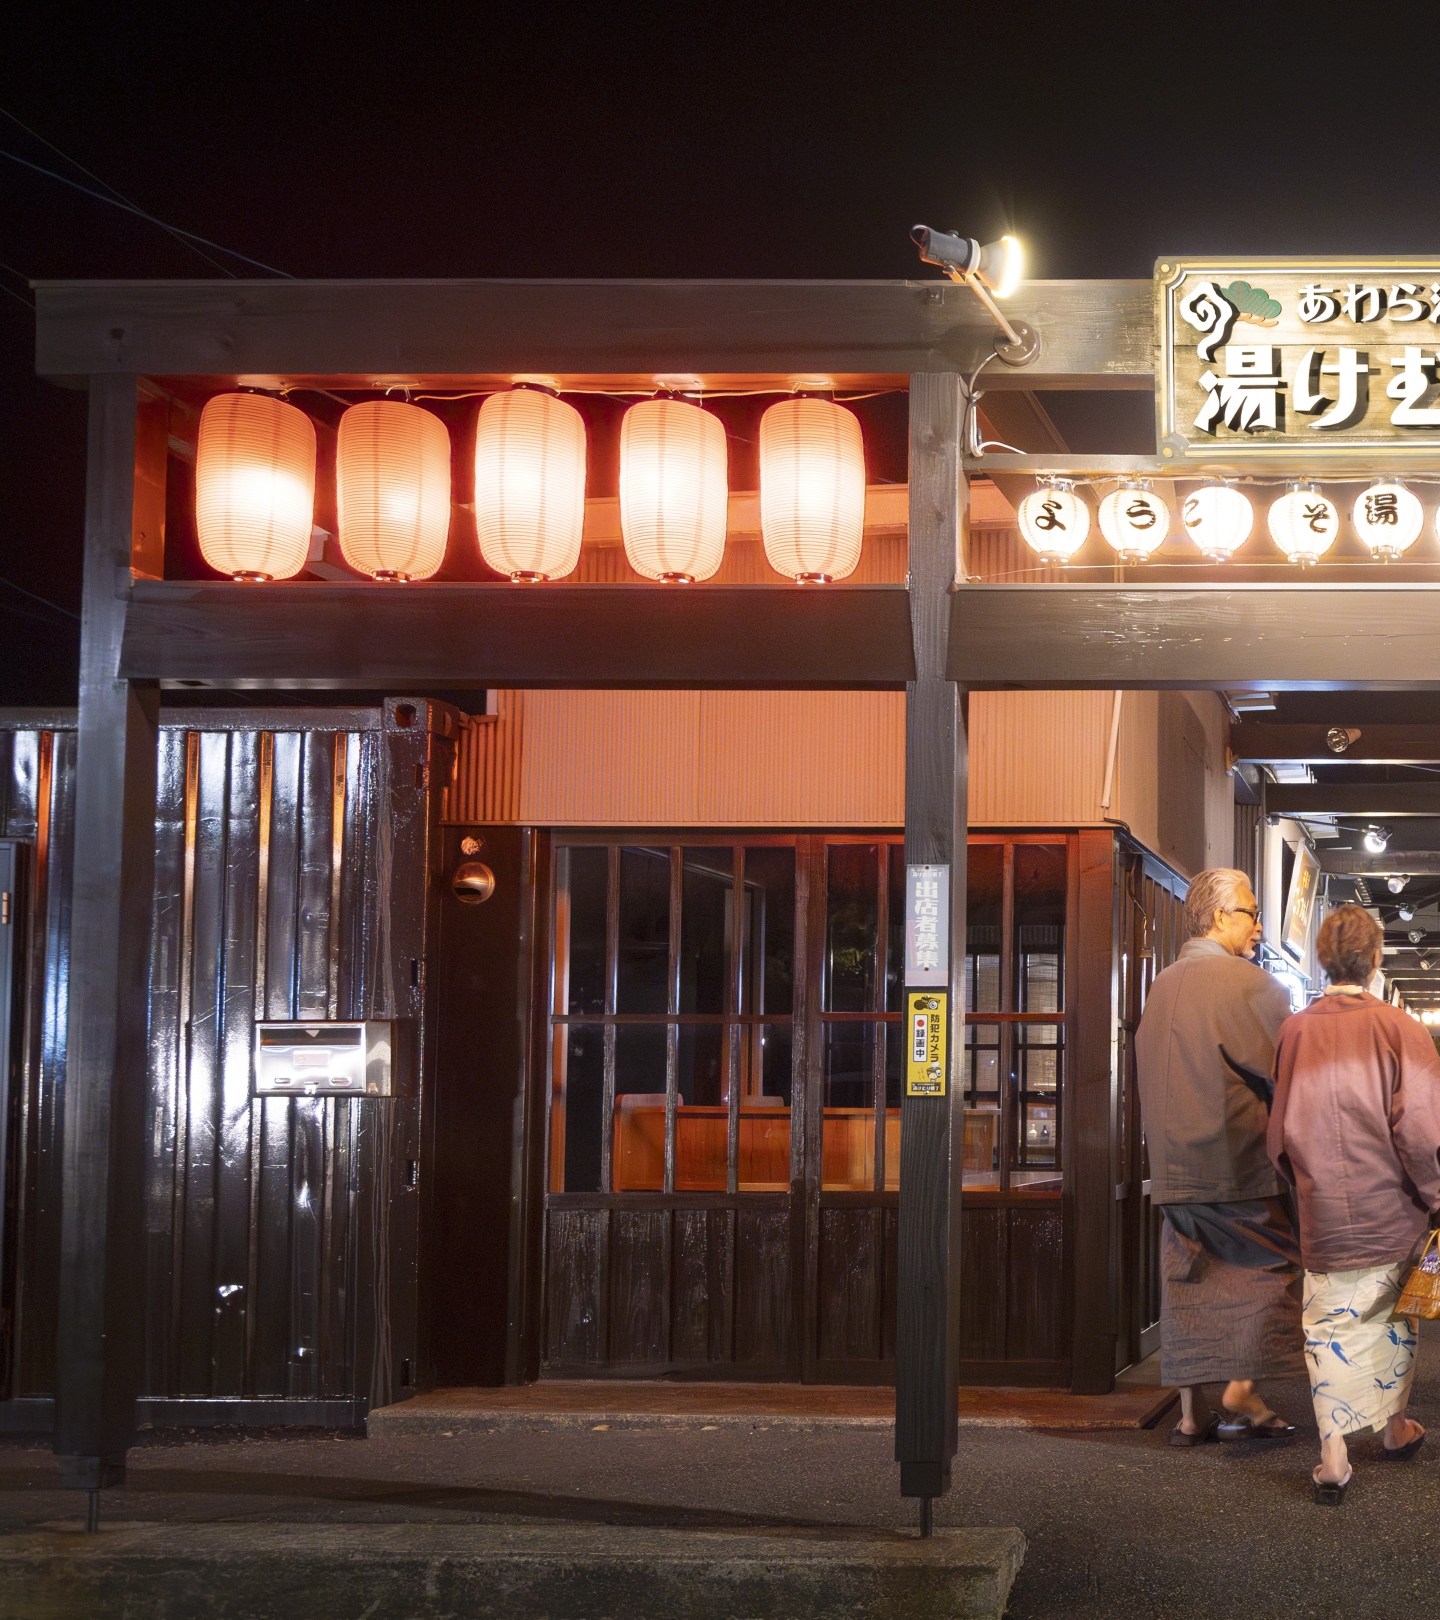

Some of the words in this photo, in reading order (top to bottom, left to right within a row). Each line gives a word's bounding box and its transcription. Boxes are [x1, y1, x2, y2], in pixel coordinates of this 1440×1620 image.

[914, 881, 939, 968] 出店者募集
[915, 1029, 925, 1058] 録画中
[930, 1014, 940, 1063] 防犯カメラ
